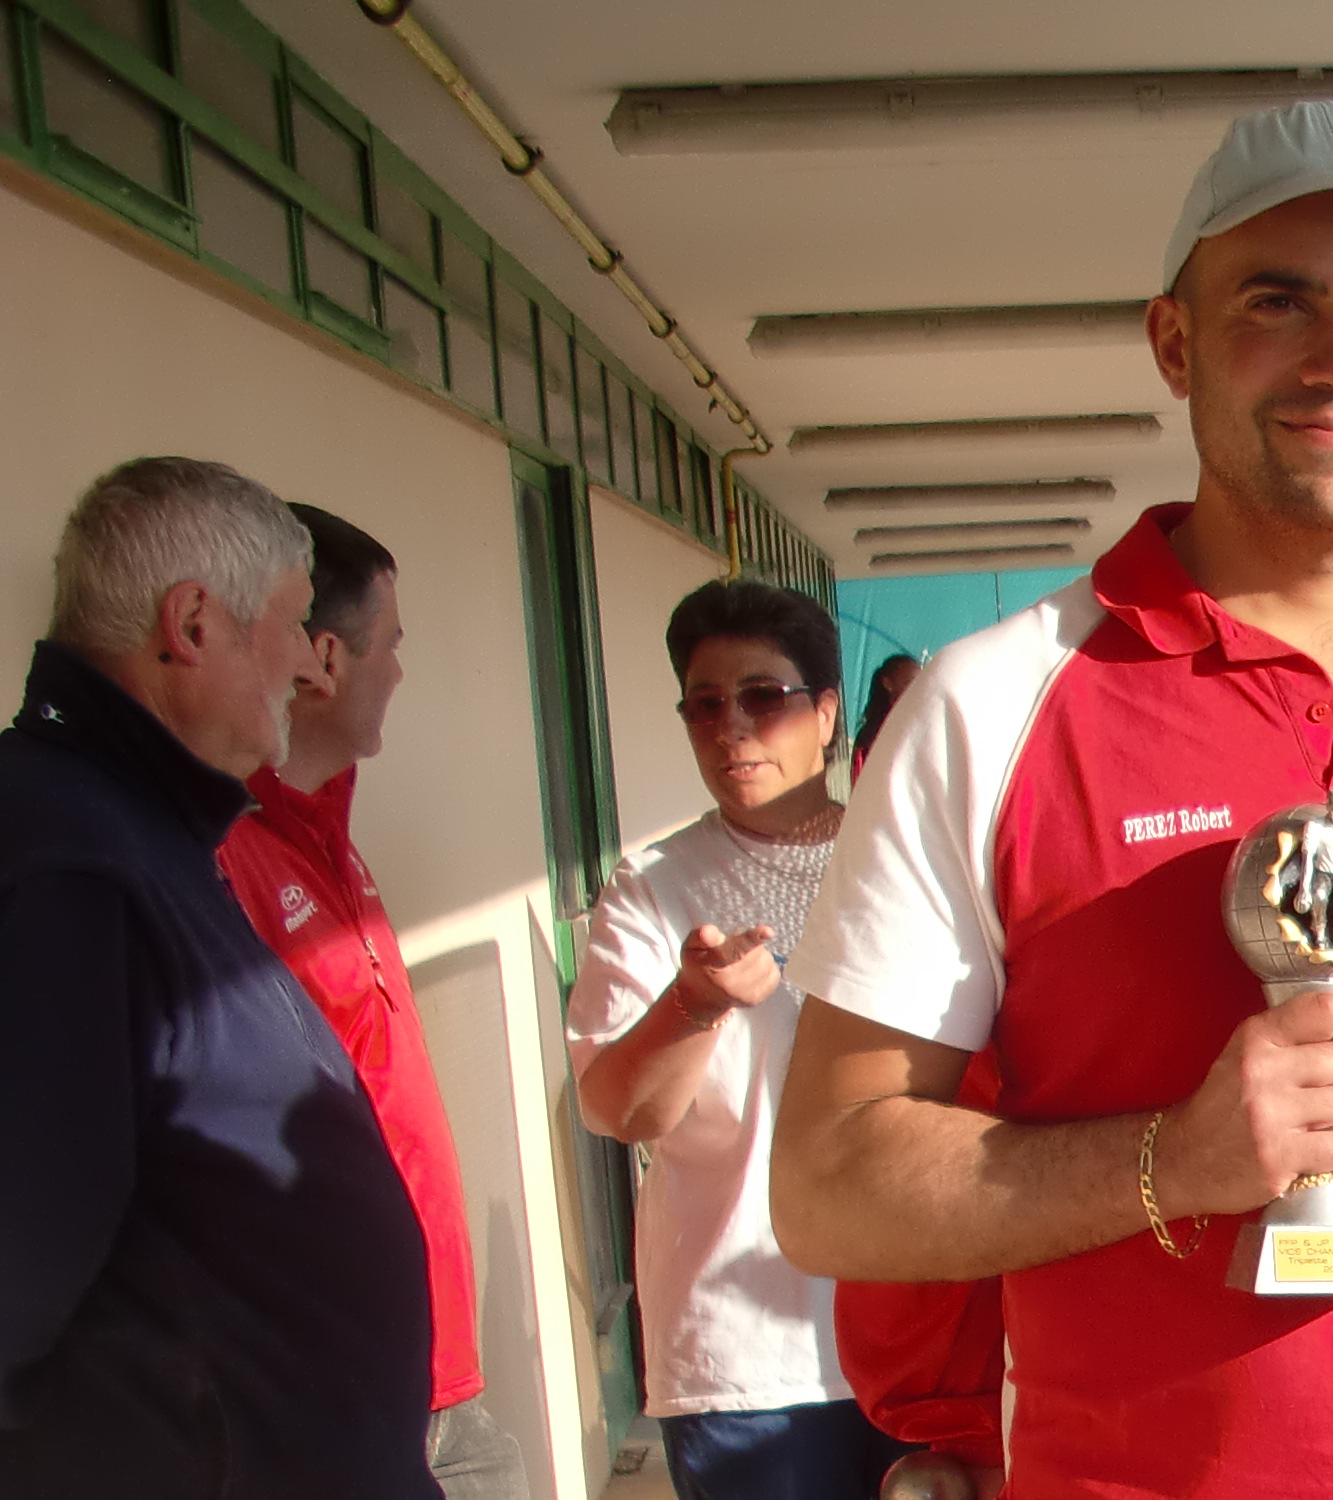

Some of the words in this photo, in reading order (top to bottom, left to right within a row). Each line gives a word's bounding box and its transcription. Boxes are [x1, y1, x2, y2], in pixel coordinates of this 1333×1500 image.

[1122, 812, 1176, 843] PEREZ
[1178, 805, 1232, 833] Robert
[1288, 1256, 1328, 1265] Triplette
